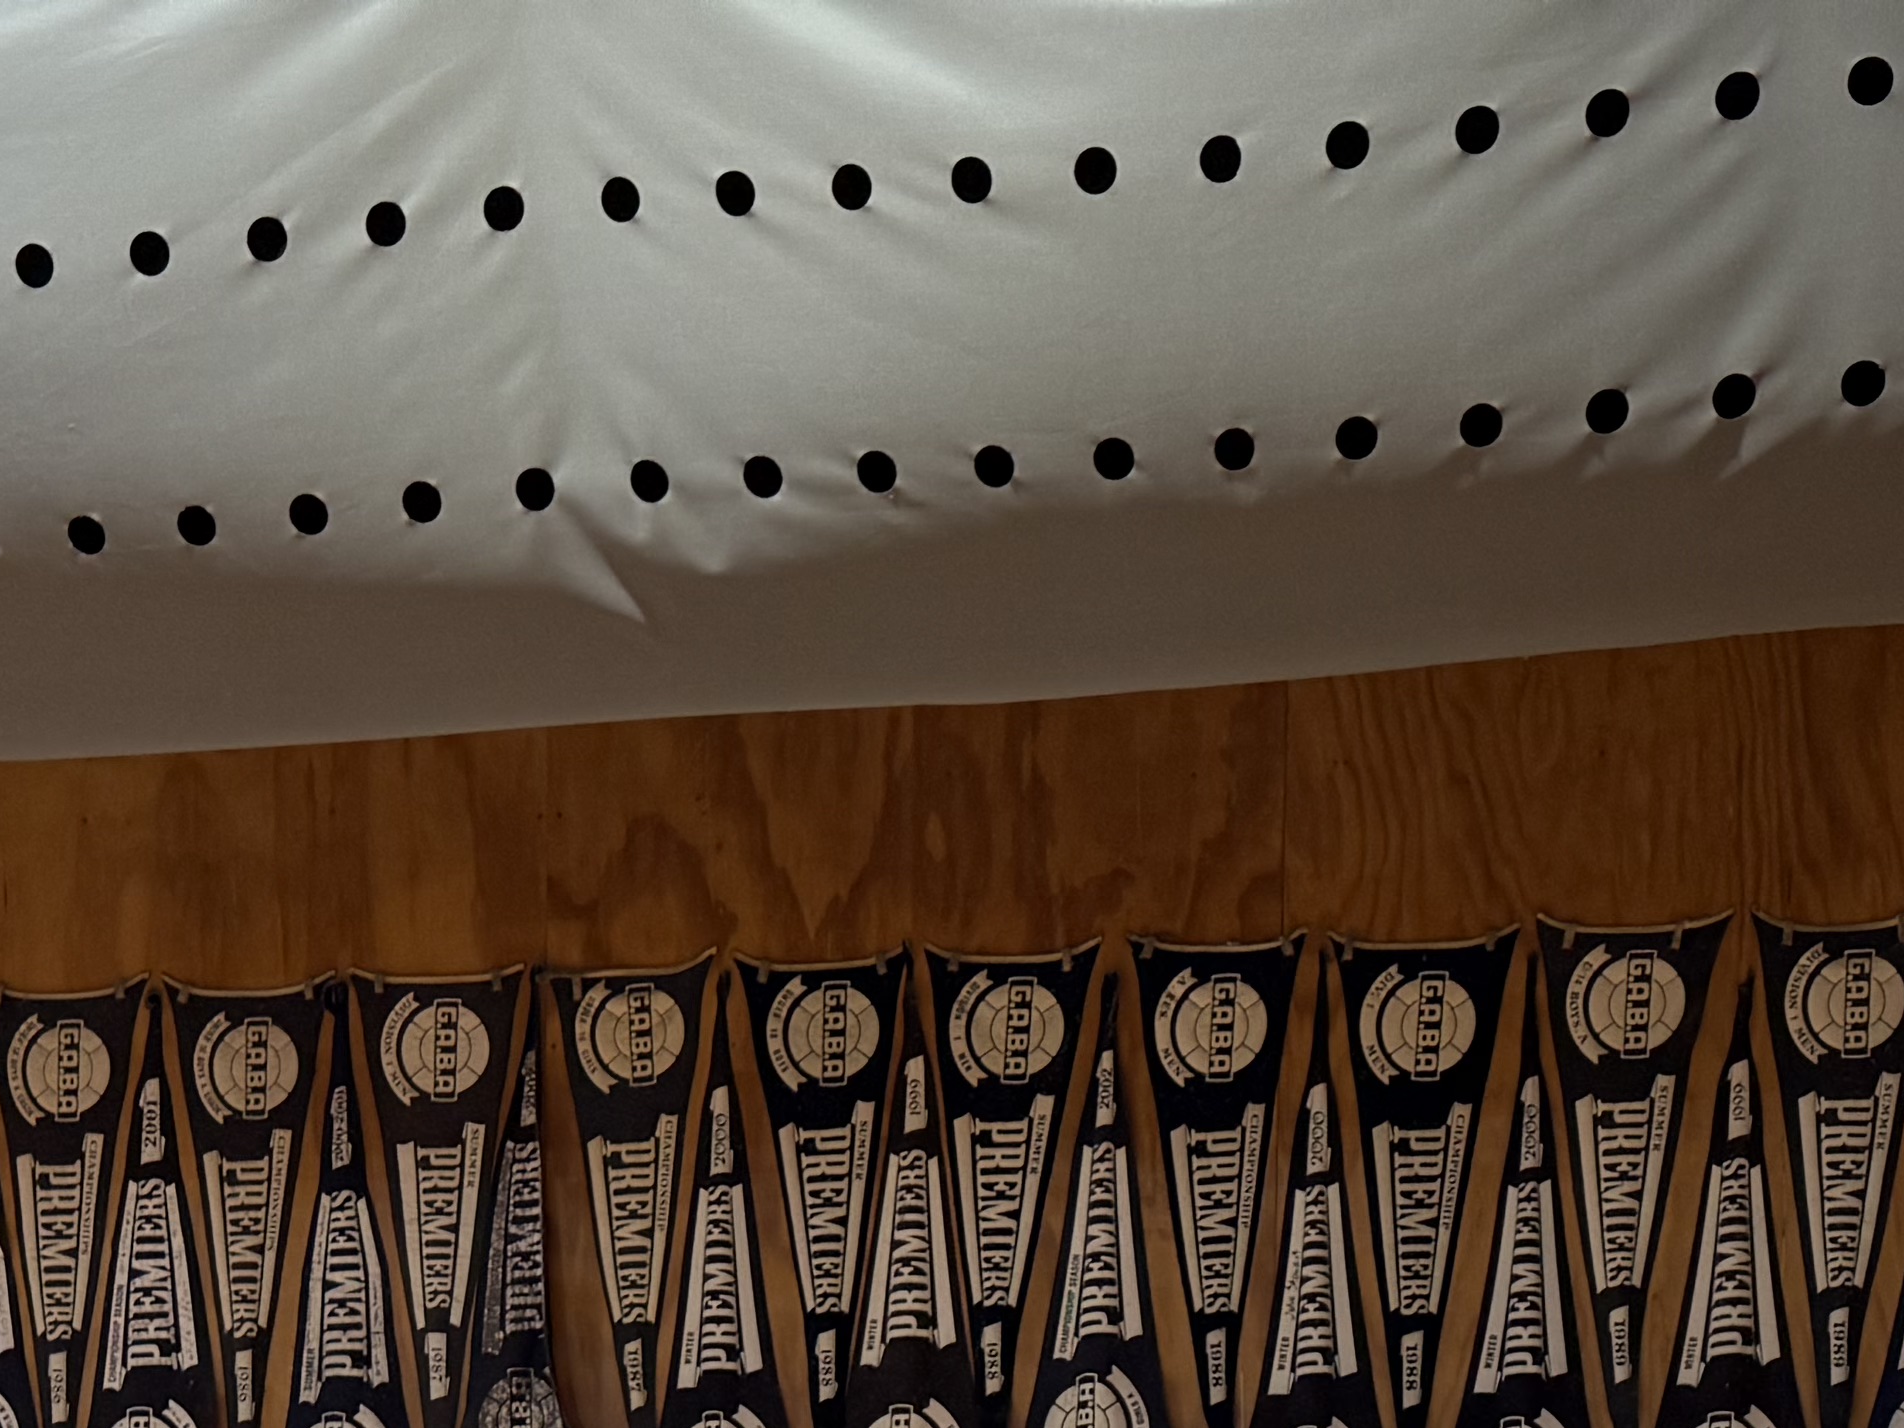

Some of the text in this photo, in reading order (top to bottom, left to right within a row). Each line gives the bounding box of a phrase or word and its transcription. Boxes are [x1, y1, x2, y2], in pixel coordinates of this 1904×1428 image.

[822, 986, 847, 1080] G.A.B.A
[1005, 983, 1034, 1078] G.A.B.A
[1209, 980, 1237, 1076] G.A.B.A
[1419, 979, 1446, 1076] G.A.B.A
[1624, 957, 1653, 1053] G.A.B.A
[1789, 949, 1820, 1023] DIVISION
[1844, 957, 1872, 1052] G.A.B.A
[58, 1026, 82, 1117] G.A.B.A
[246, 1023, 269, 1113] G.A.B.A
[434, 1004, 460, 1095] G.A.B.A
[629, 990, 654, 1080] G.A.B.A
[1163, 1046, 1186, 1080] MEN
[1368, 1042, 1391, 1077] MEN
[145, 1102, 161, 1146] 2001
[910, 1078, 922, 1117] 1999
[1099, 1066, 1113, 1110] 2002
[1523, 1103, 1538, 1162] 2000
[1651, 1084, 1670, 1152] SUMMER
[1732, 1083, 1746, 1122] 1999
[714, 1114, 726, 1166] 2000
[855, 1119, 869, 1181] SUMMER
[1242, 1111, 1261, 1228] CHAMPIONSHIP
[1310, 1109, 1325, 1165] 2000
[1443, 1113, 1465, 1230] CHAMPIONSHIP
[416, 1145, 462, 1310] PREMIERS
[606, 1137, 656, 1326] PREMIERS
[799, 1126, 850, 1313] PREMIERS
[974, 1118, 1028, 1308] PREMIERS
[1080, 1140, 1124, 1339] PREMIERS
[1190, 1127, 1241, 1316] PREMIERS
[1394, 1126, 1445, 1316] PREMIERS
[1596, 1099, 1647, 1290] PREMIERS
[1819, 1096, 1872, 1290] PREMIERS
[34, 1161, 80, 1341] PREMIERS
[128, 1178, 178, 1370] PREMIERS
[222, 1157, 267, 1339] PREMIERS
[321, 1190, 367, 1380] PREMIERS
[700, 1183, 741, 1375] PREMIERS
[887, 1148, 933, 1344] PREMIERS
[1296, 1182, 1339, 1379] PREMIERS
[1502, 1180, 1547, 1379] PREMIERS
[1709, 1157, 1754, 1356] PREMIERS
[431, 1346, 444, 1383] 1987
[627, 1347, 641, 1392] 1987
[1210, 1339, 1224, 1388] 1988
[1405, 1346, 1419, 1392] 1988
[1485, 1333, 1499, 1370] WINTER
[1614, 1320, 1628, 1369] 1989
[1833, 1322, 1846, 1369] 1989
